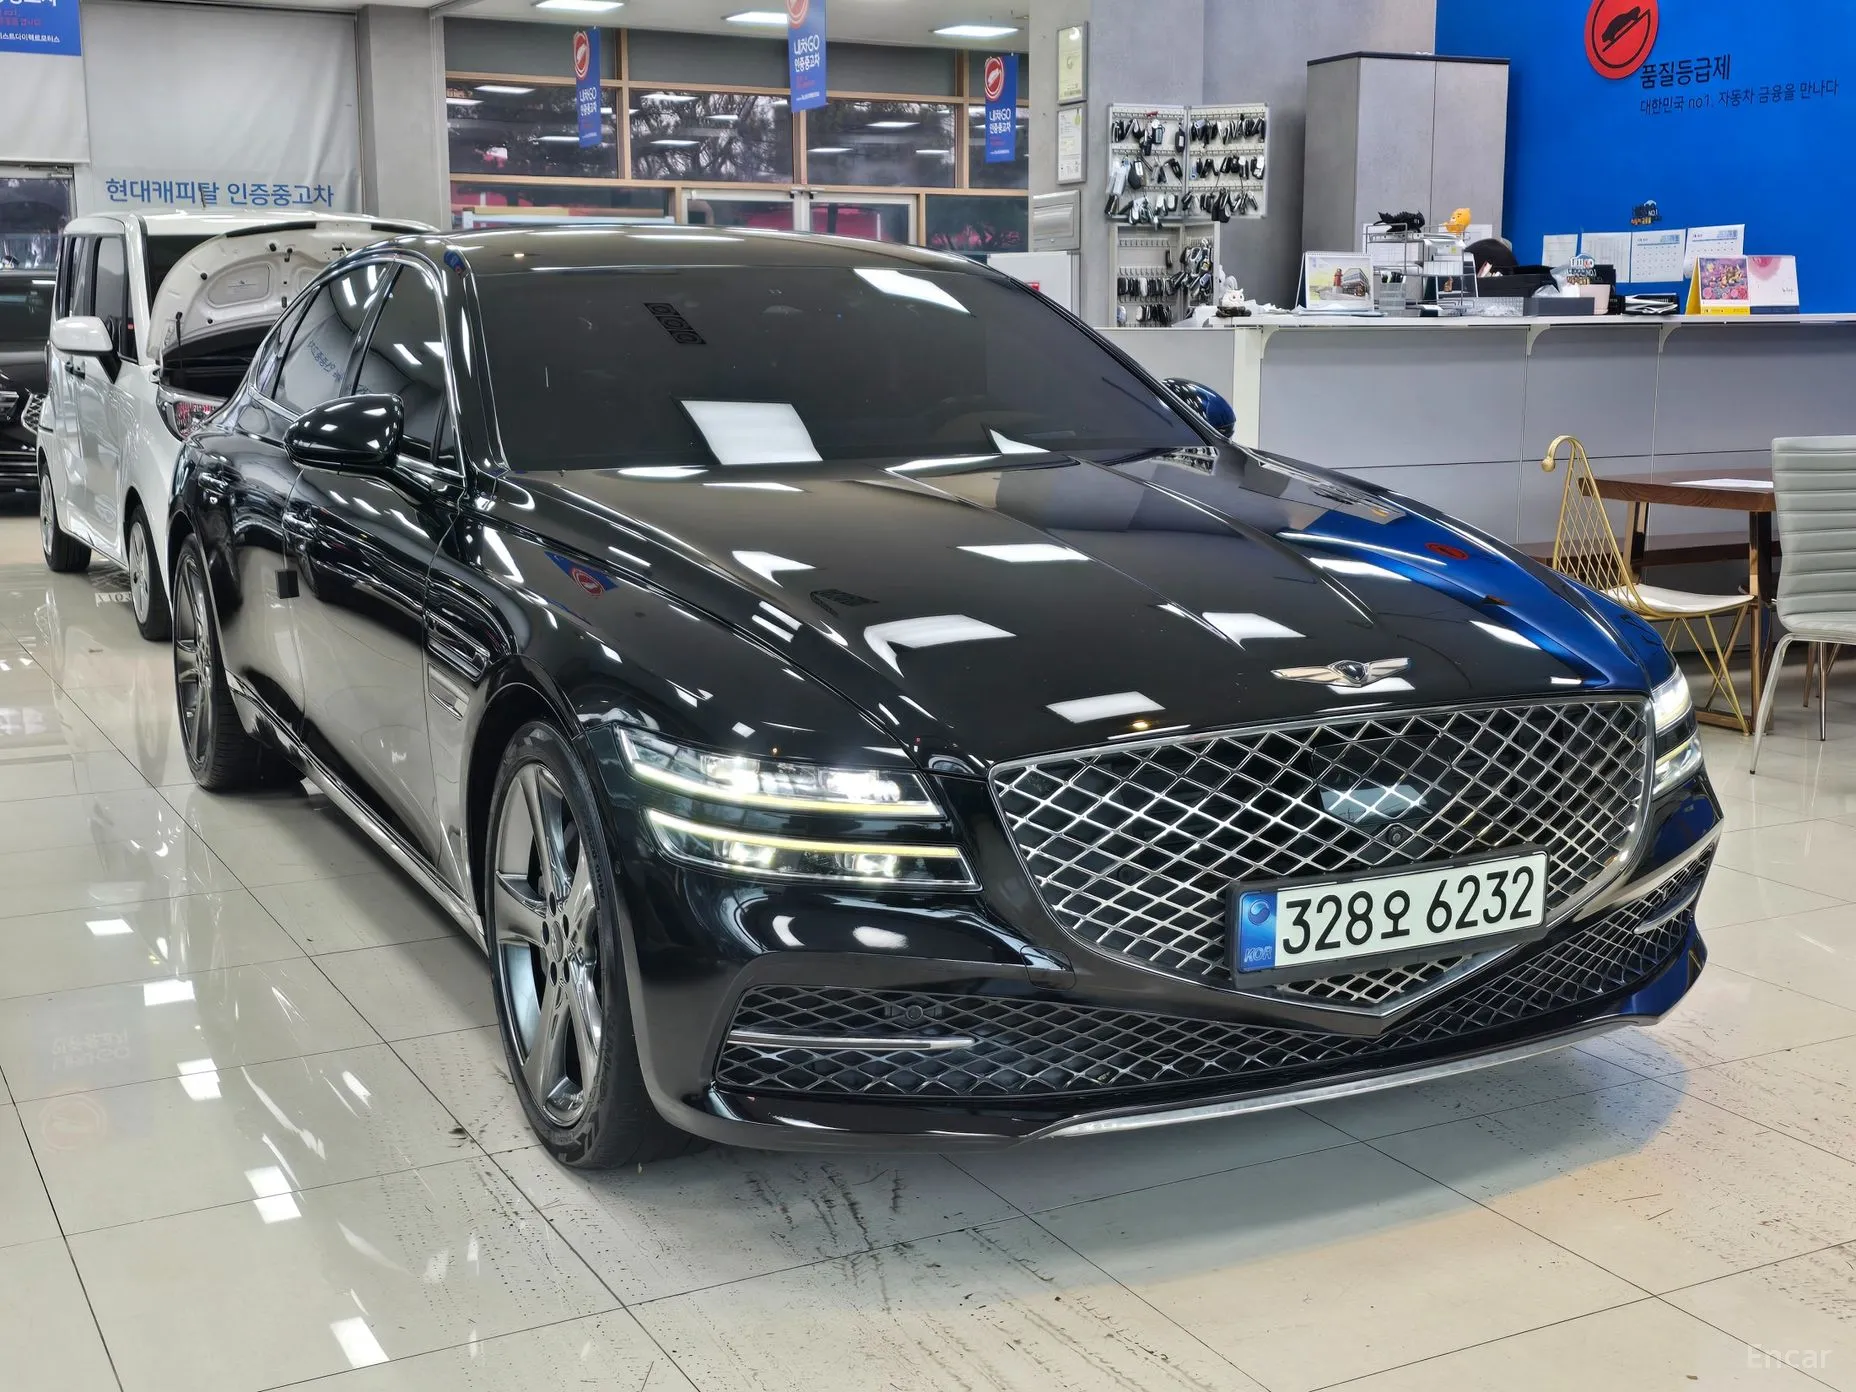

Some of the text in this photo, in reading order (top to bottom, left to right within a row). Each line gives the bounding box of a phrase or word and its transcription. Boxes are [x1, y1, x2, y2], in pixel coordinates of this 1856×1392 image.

[794, 52, 820, 73] 인증중고차
[1640, 53, 1731, 90] 품질등급제
[1640, 95, 1685, 115] 대한민국
[1718, 87, 1754, 107] 자동차
[1758, 82, 1796, 104] 금융을
[1800, 77, 1839, 99] 만나다
[105, 177, 335, 208] 현대캐피탈 인증중고차
[1282, 865, 1535, 955] 328오 6232
[1244, 945, 1273, 963] KOR
